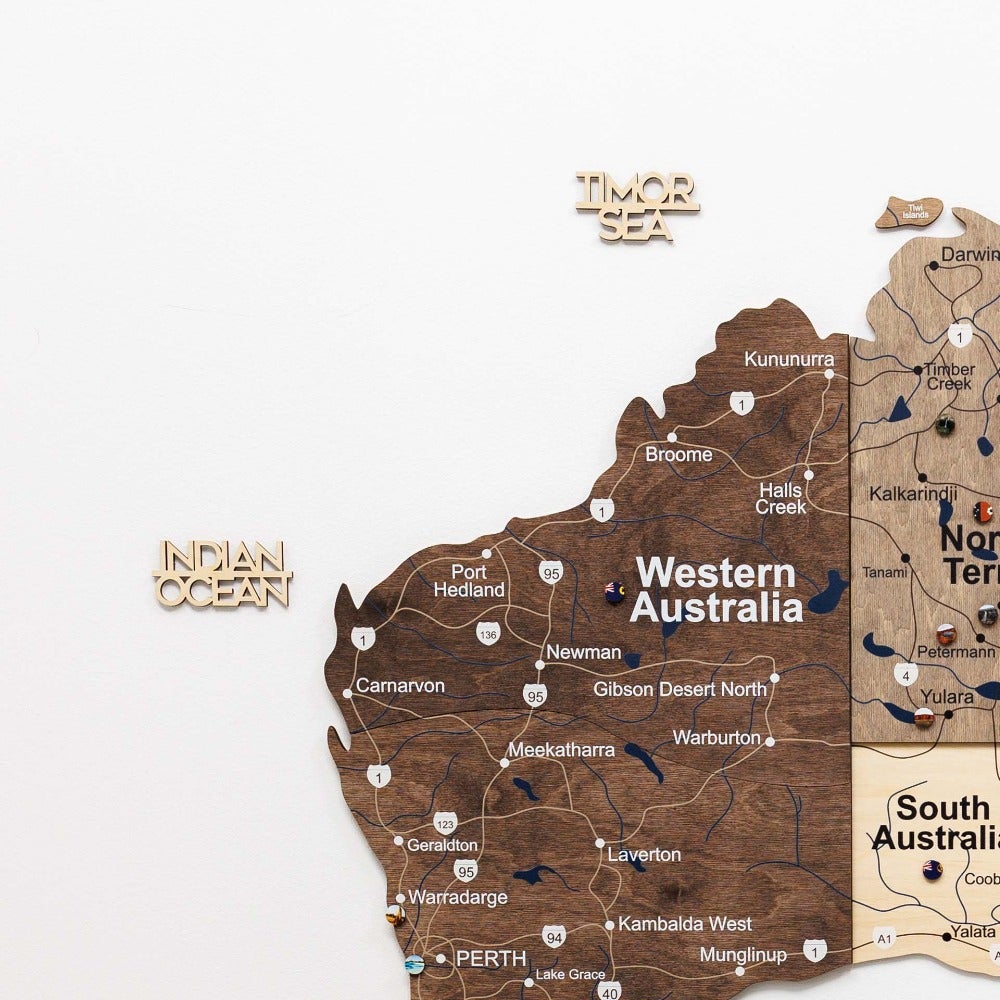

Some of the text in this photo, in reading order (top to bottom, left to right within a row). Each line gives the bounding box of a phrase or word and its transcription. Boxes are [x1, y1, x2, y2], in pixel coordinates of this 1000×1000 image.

[576, 171, 696, 206] TIMOR
[599, 206, 673, 241] SEA
[942, 247, 1000, 262] Darwin
[744, 351, 835, 368] Kununurra
[924, 363, 975, 376] Timber
[927, 378, 971, 390] Creek
[739, 400, 744, 410] 1
[646, 447, 713, 462] Broome
[760, 483, 802, 499] Halls
[870, 487, 958, 502] Kalkarindji
[600, 506, 605, 517] 1
[755, 499, 807, 515] Creek
[159, 540, 285, 574] INDIAN
[452, 565, 487, 580] Port
[544, 569, 560, 580] 95
[636, 556, 796, 588] Western
[863, 567, 907, 578] Tanami
[155, 573, 289, 607] OCEAN
[434, 583, 505, 598] Hedland
[630, 592, 803, 623] Australia
[360, 635, 366, 646] 1
[480, 631, 496, 640] 136
[547, 645, 621, 661] Newman
[918, 646, 995, 658] Petermann
[356, 678, 445, 693] Carnarvon
[594, 682, 766, 698] Gibson Desert North
[921, 689, 973, 704] Yulara
[673, 730, 761, 746] Warburton
[509, 742, 615, 758] Meekatharra
[897, 795, 990, 820] South
[407, 838, 478, 852] Geraldton
[608, 847, 682, 863] Laverton
[409, 890, 507, 909] Warradarge
[618, 916, 752, 932] Kambalda West
[951, 925, 996, 938] Yalata
[878, 935, 892, 944] A1
[457, 951, 526, 967] PERTH
[700, 946, 787, 964] Munglinup
[536, 968, 606, 981] Lake Grace
